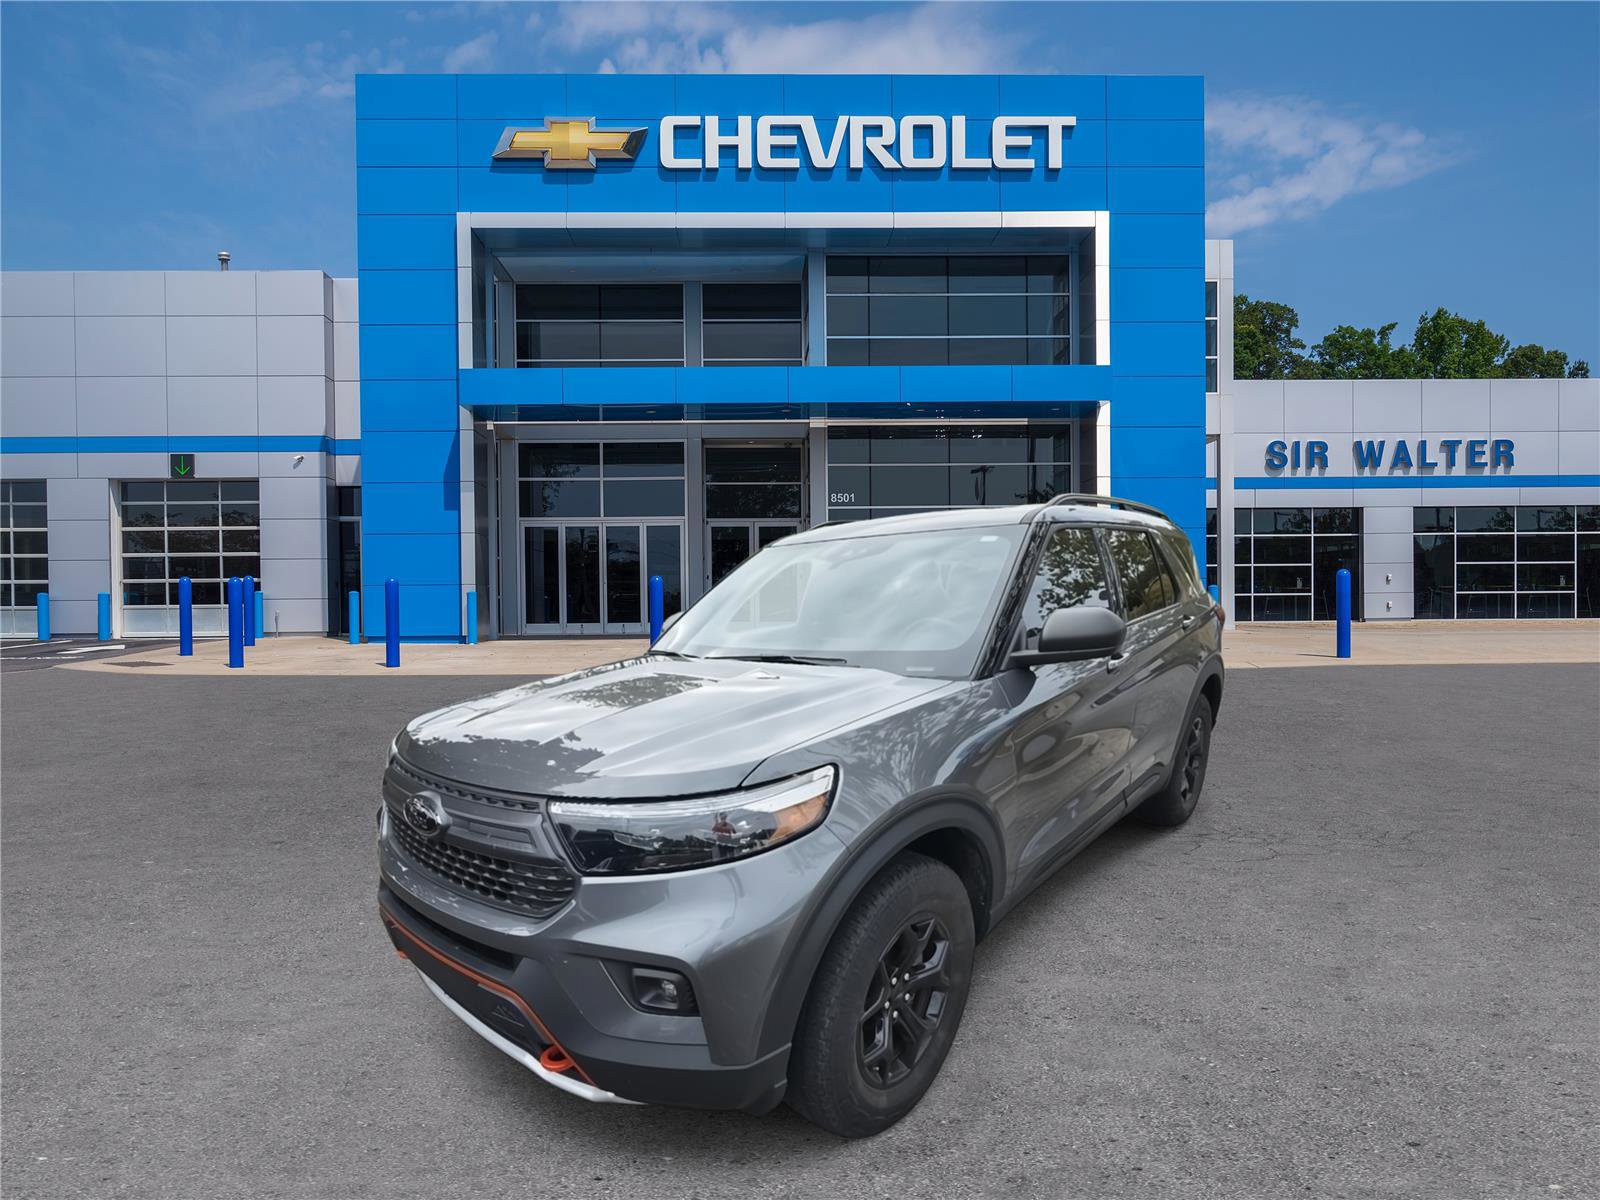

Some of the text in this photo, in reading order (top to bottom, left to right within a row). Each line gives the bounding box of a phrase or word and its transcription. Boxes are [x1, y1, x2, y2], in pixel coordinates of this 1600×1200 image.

[660, 115, 1077, 170] CHEVROLET
[1265, 439, 1516, 470] SIR WALTER
[830, 493, 856, 503] 8501
